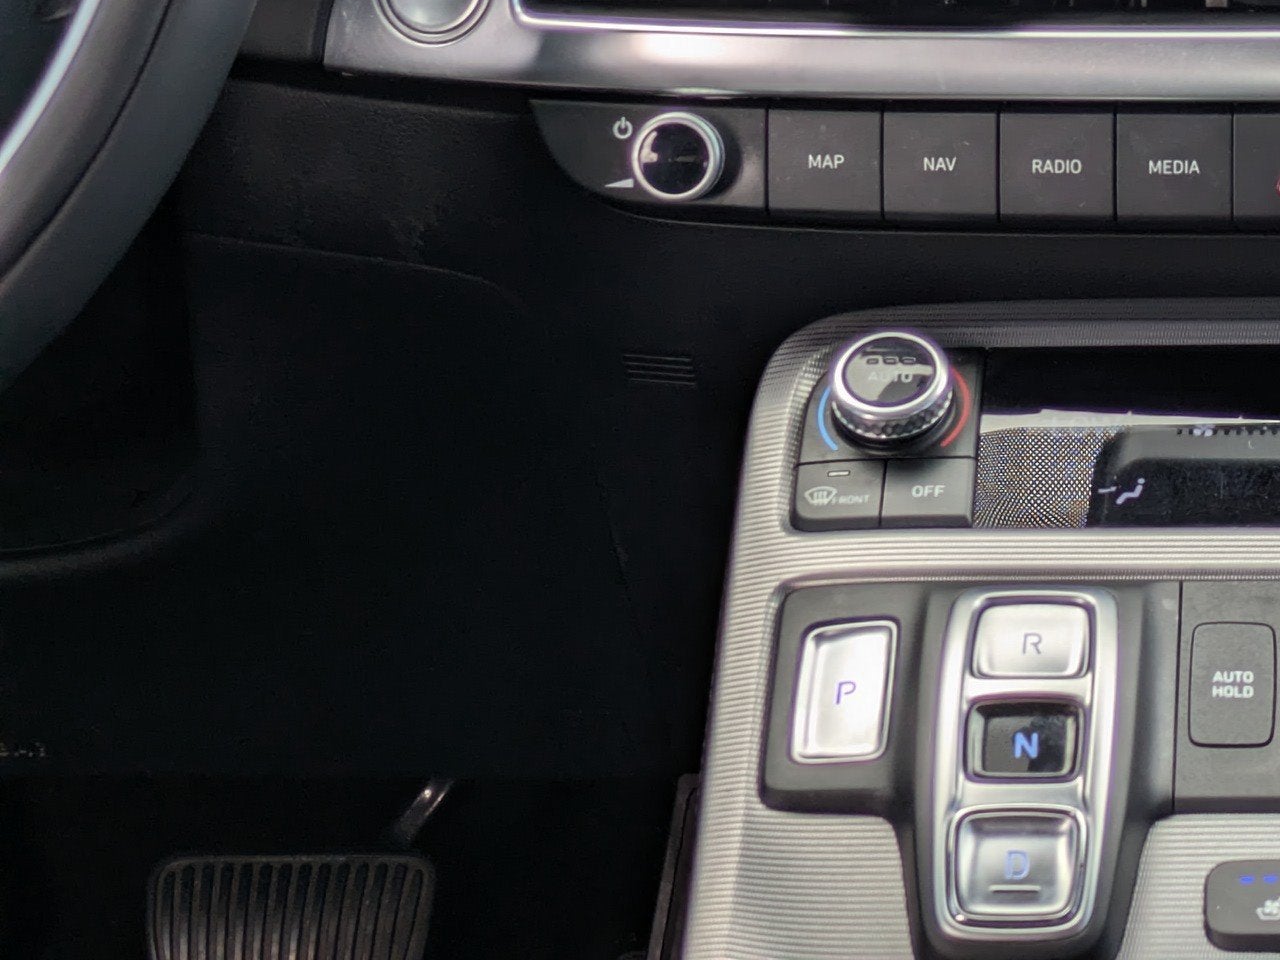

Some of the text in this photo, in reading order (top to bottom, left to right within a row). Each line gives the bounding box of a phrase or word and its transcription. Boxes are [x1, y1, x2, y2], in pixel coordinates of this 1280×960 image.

[808, 154, 844, 171] MAP
[923, 156, 957, 172] NAV
[1031, 158, 1082, 175] RADIO
[1148, 160, 1200, 176] MEDIA
[912, 485, 945, 498] OFF
[1022, 632, 1042, 655] R
[1212, 671, 1254, 684] AUTO
[835, 680, 856, 705] P
[1212, 685, 1254, 699] HOLD
[1013, 732, 1039, 759] N
[1005, 850, 1030, 880] D
